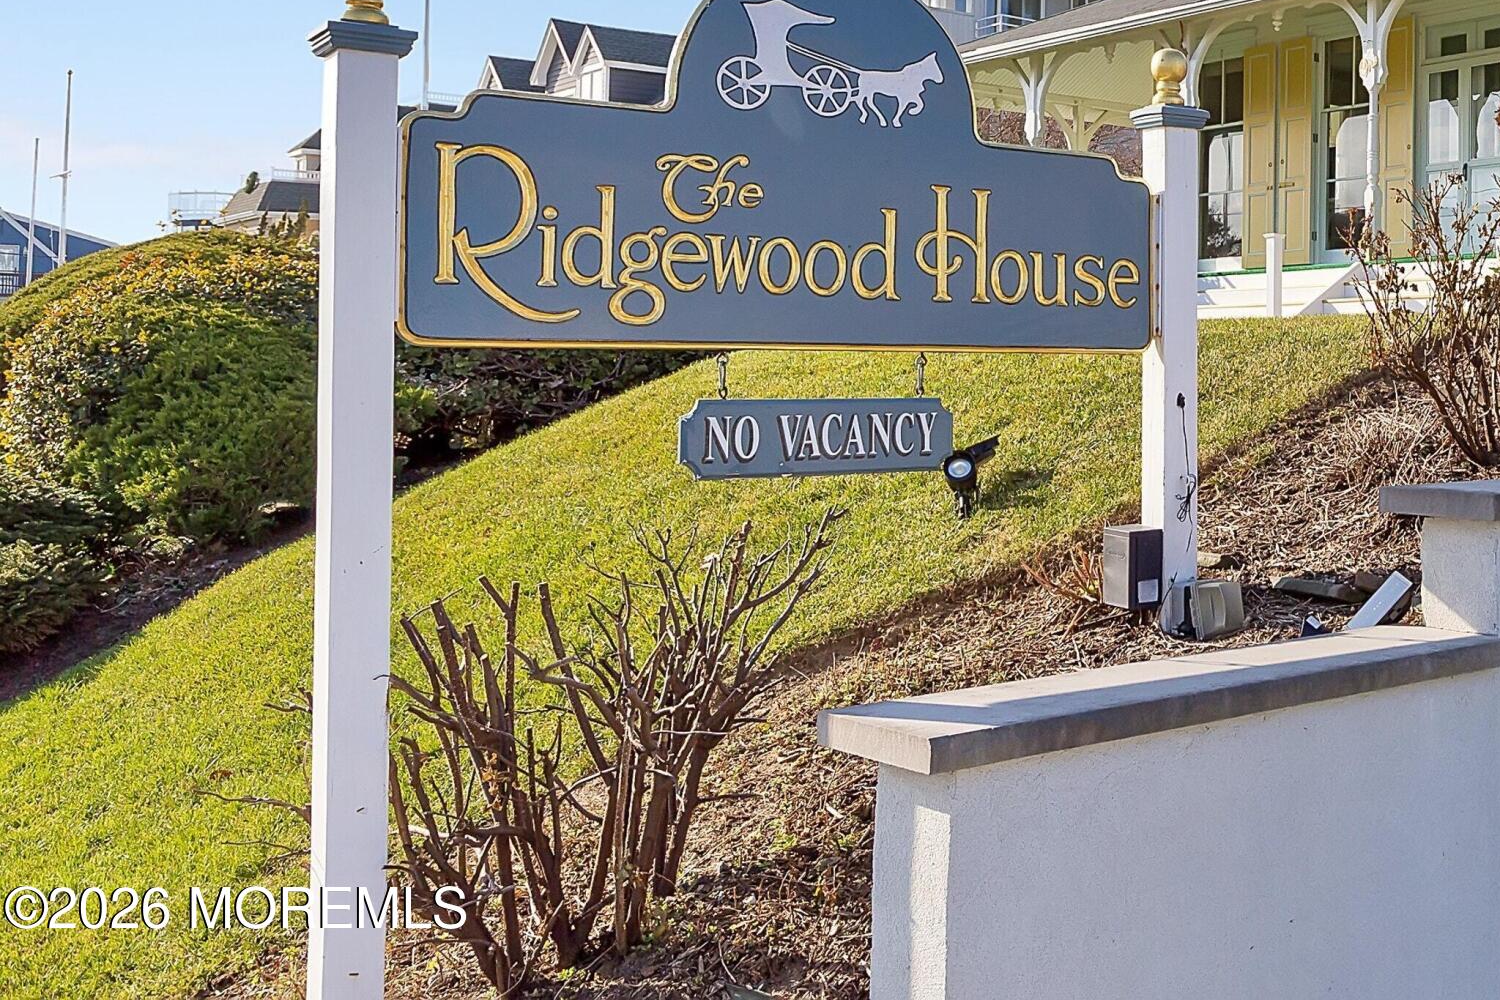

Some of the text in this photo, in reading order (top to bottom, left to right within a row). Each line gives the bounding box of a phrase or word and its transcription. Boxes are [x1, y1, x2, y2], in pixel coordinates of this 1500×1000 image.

[656, 153, 764, 222] The
[433, 142, 1140, 326] Ridgewood House
[703, 411, 937, 462] NO VACANCY
